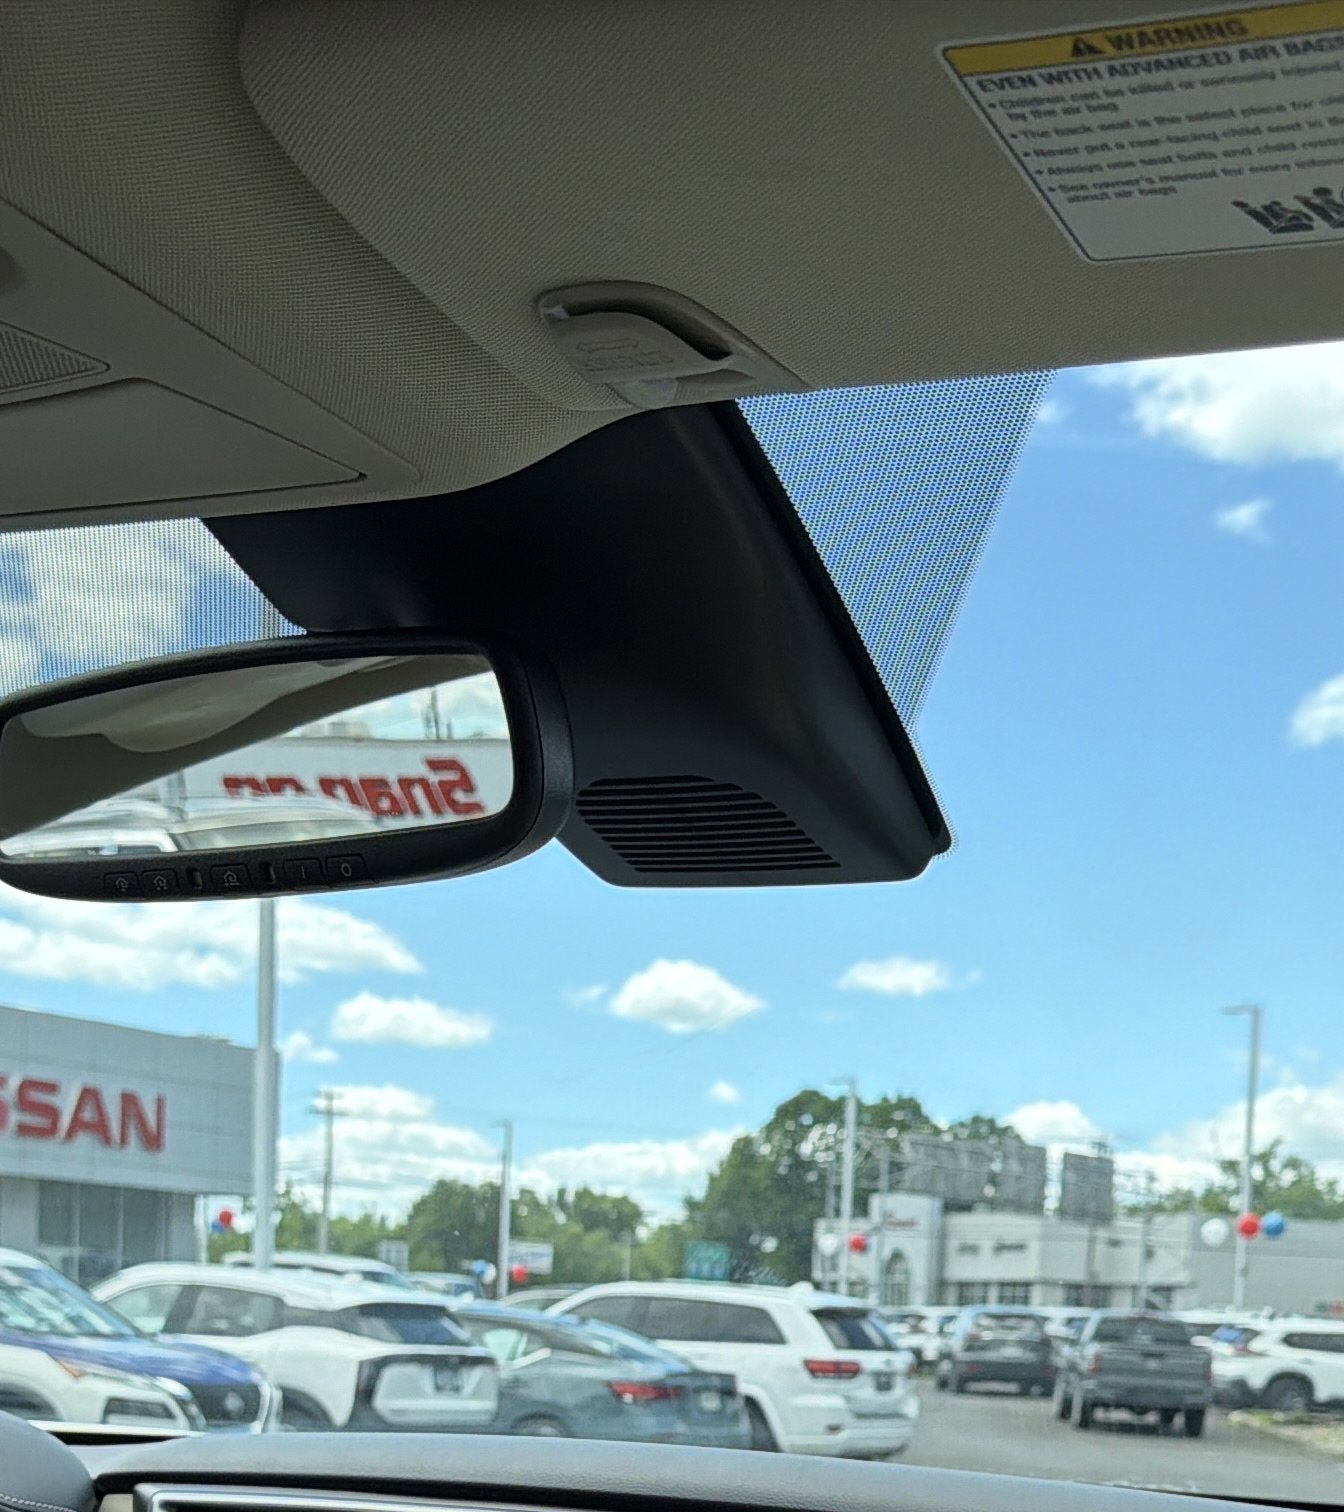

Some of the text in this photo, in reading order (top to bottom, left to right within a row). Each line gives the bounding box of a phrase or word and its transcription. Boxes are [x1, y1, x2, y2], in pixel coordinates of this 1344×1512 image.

[1104, 17, 1248, 51] WARNING
[976, 73, 1038, 93] EVEN
[1038, 66, 1103, 86] WITH
[1106, 50, 1233, 78] ADVANCED
[1238, 44, 1281, 63] AIR
